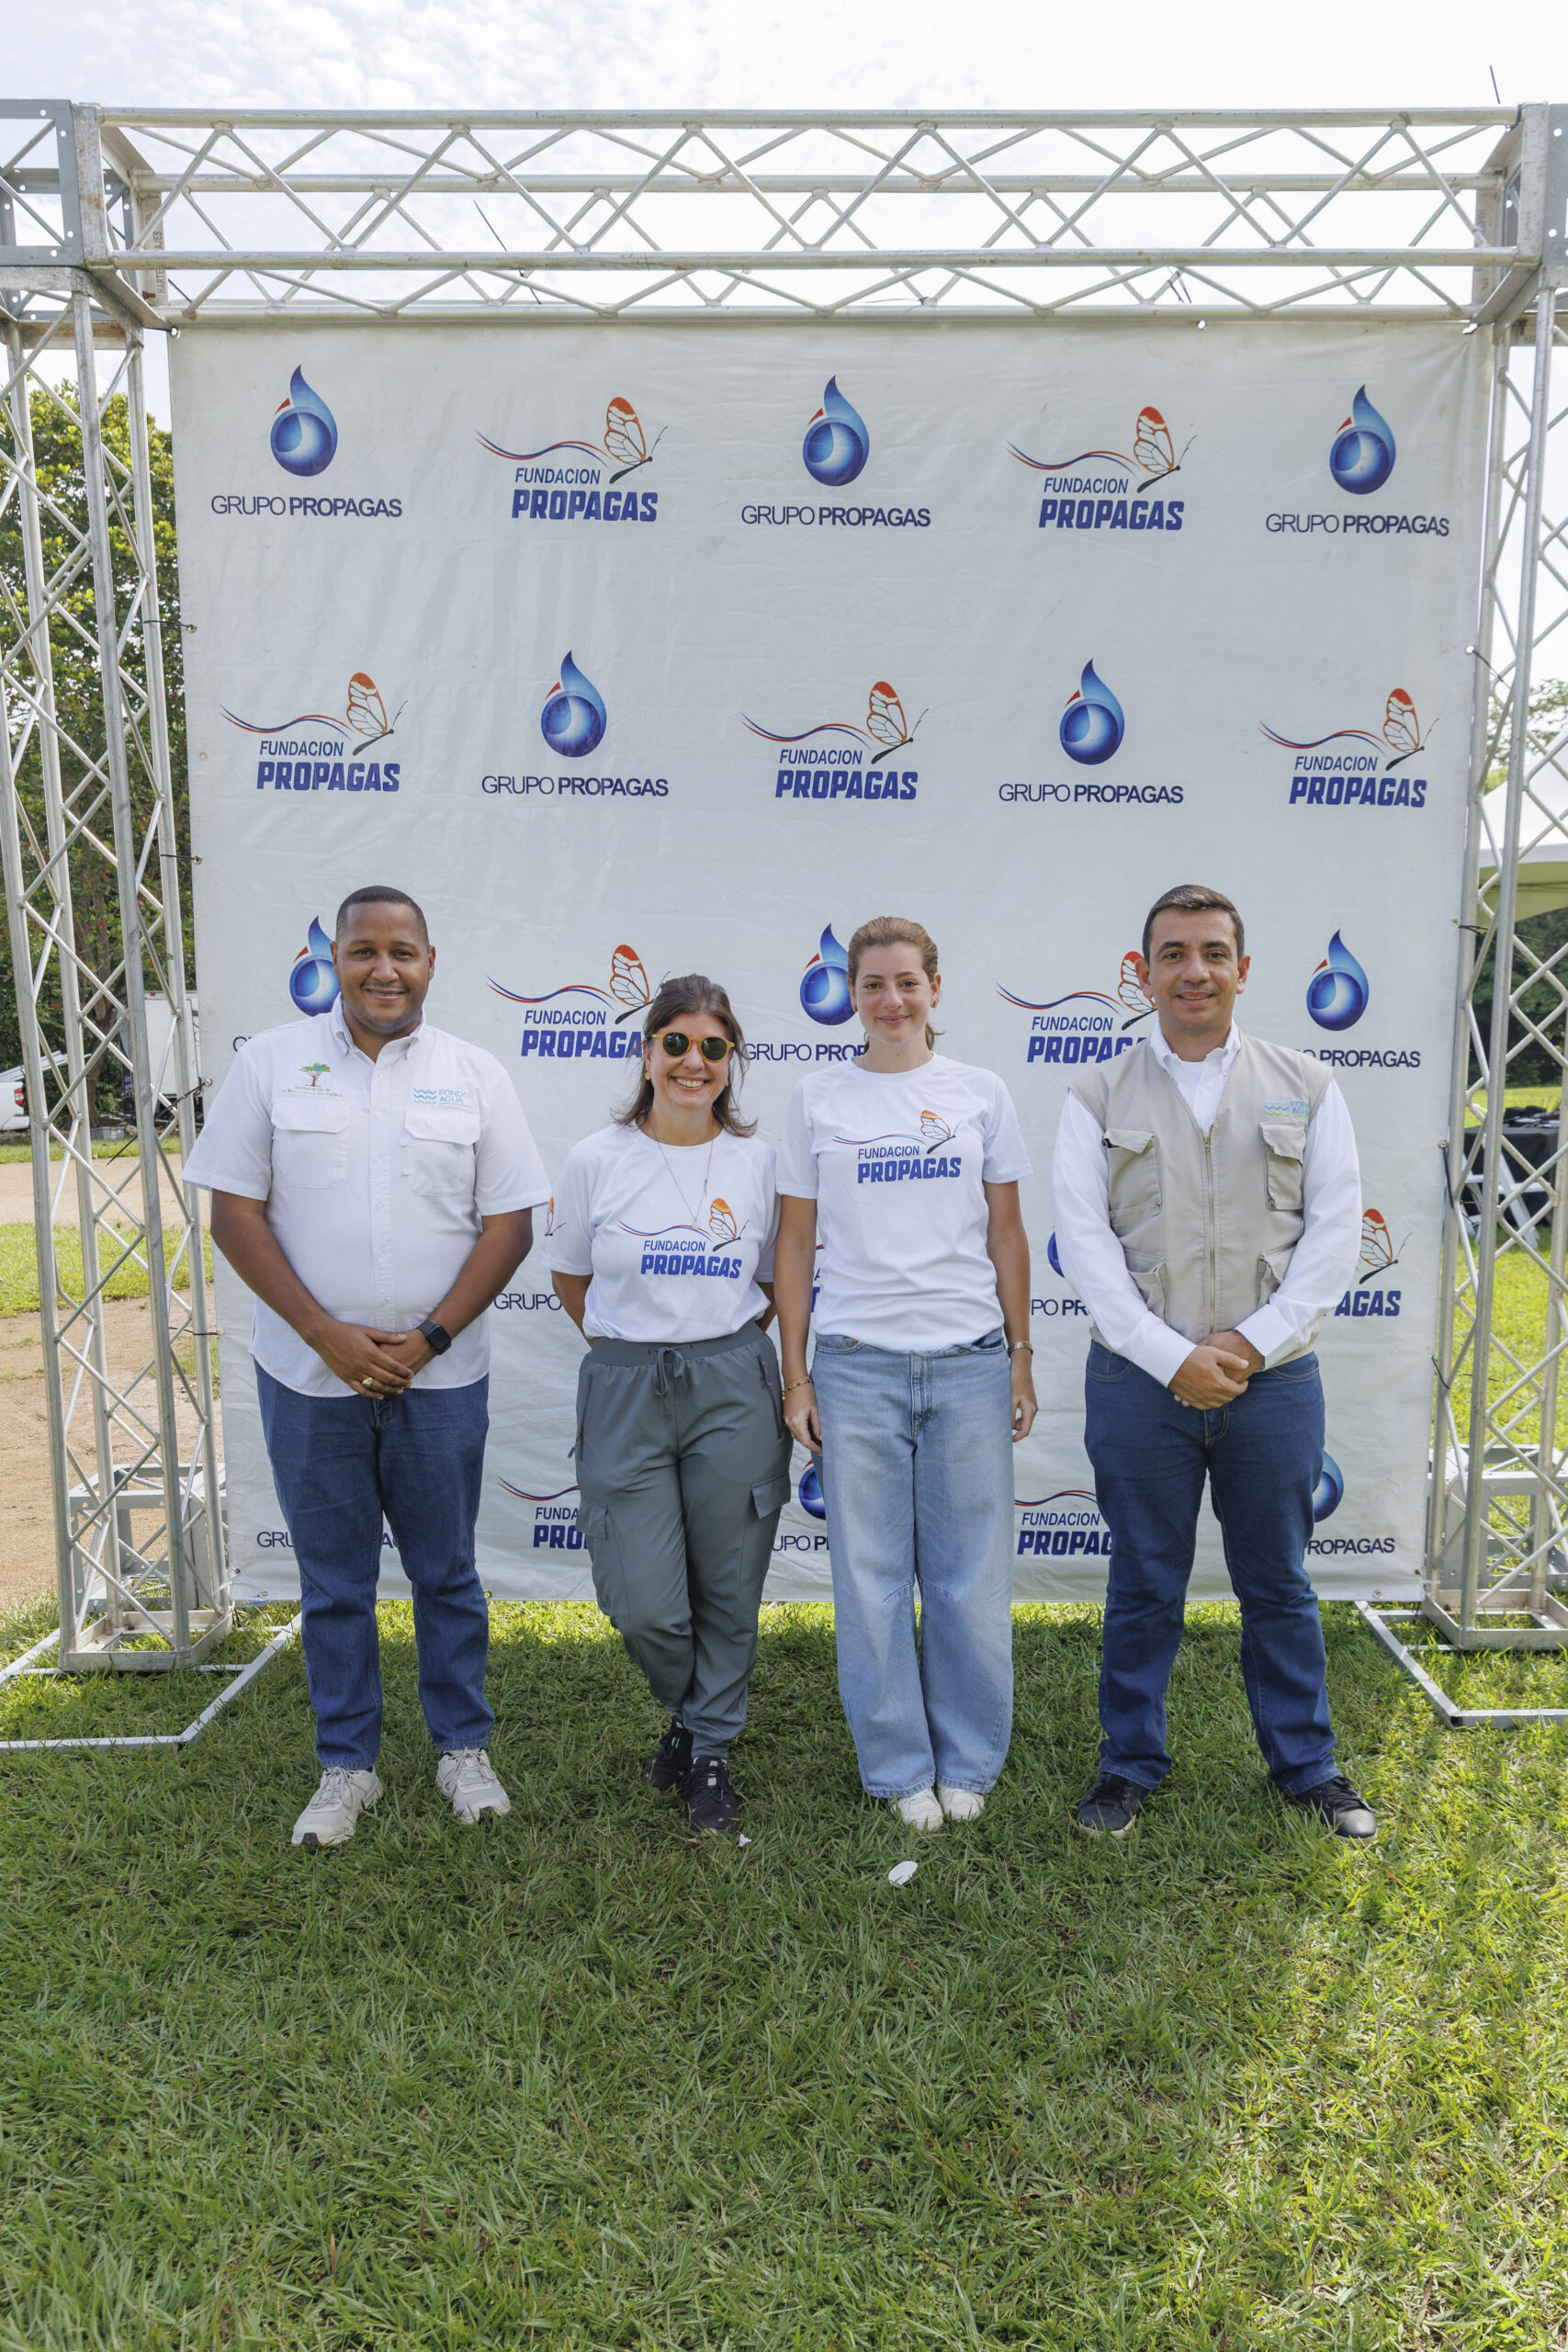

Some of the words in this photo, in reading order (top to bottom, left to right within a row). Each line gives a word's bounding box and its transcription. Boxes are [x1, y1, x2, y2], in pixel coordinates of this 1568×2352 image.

[514, 467, 602, 485] FUNDACION
[1043, 477, 1129, 494] FUNDACION
[210, 494, 287, 516] GRUPO
[289, 496, 403, 518] PROPAGAS
[511, 489, 659, 523] PROPAGAS
[740, 504, 817, 526] GRUPO
[818, 506, 931, 528] PROPAGAS
[1038, 498, 1185, 531] PROPAGAS
[1265, 513, 1340, 534] GRUPO
[1342, 514, 1450, 537] PROPAGAS
[259, 740, 344, 757] FUNDACION
[779, 749, 863, 765] FUNDACION
[1294, 755, 1379, 772] FUNDACION
[256, 761, 401, 793] PROPAGAS
[481, 775, 556, 796] GRUPO
[558, 776, 670, 797] PROPAGAS
[774, 769, 919, 800] PROPAGAS
[998, 783, 1071, 803] GRUPO
[1073, 784, 1184, 804] PROPAGAS
[1288, 775, 1427, 808] PROPAGAS
[524, 1010, 607, 1025] FUNDACION
[1031, 1015, 1114, 1032] FUNDACION
[520, 1029, 643, 1059] PROPAGA
[743, 1043, 813, 1061] GRUPO
[1319, 1049, 1421, 1069] PROPAGAS
[857, 1145, 920, 1159] FUNDACION
[857, 1157, 963, 1184] PROPAGAS
[643, 1239, 706, 1252] FUNDACION
[640, 1254, 742, 1279] PROPAGAS
[493, 1293, 562, 1311] GRUPO
[1333, 1290, 1402, 1317] AGAS
[535, 1507, 580, 1521] FUNDA
[1021, 1511, 1100, 1526] FUNDACION
[1307, 1537, 1395, 1555] ROPAGAS
